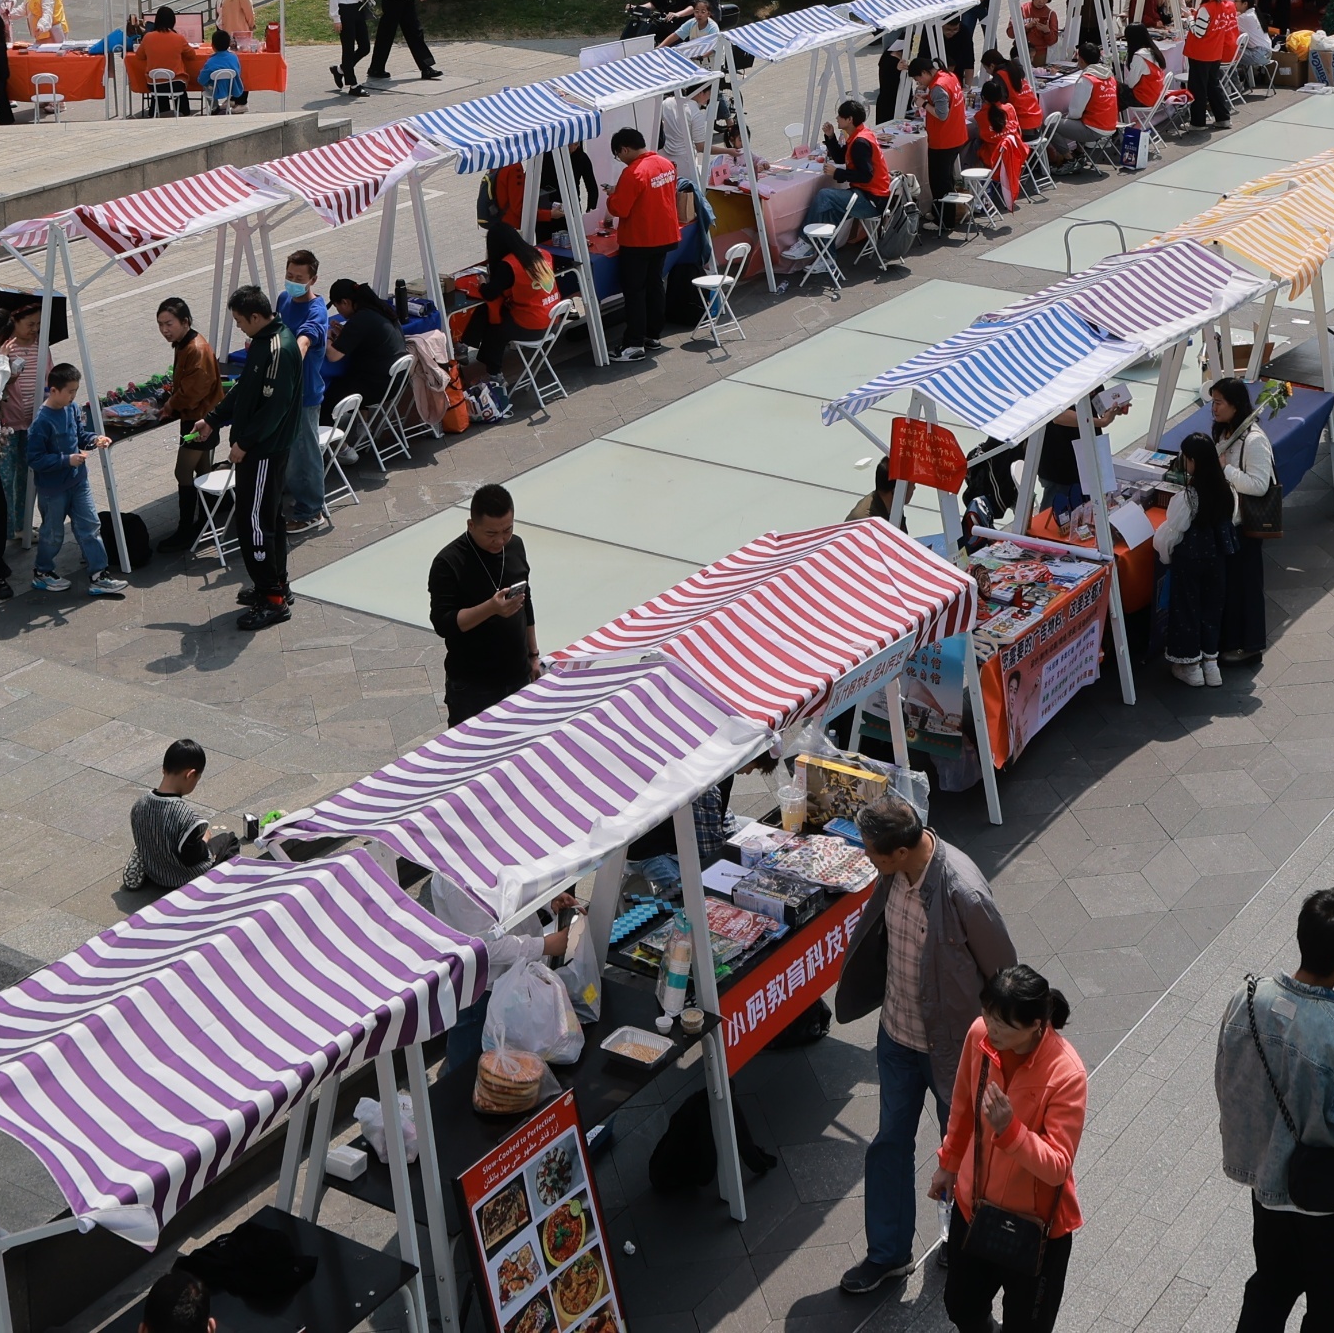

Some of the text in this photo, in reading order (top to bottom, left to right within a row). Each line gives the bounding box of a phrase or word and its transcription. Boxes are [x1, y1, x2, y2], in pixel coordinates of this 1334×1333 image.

[728, 900, 870, 1047] 小码教育科技有
[482, 1113, 556, 1175] Slow-Cooked to Perfection
